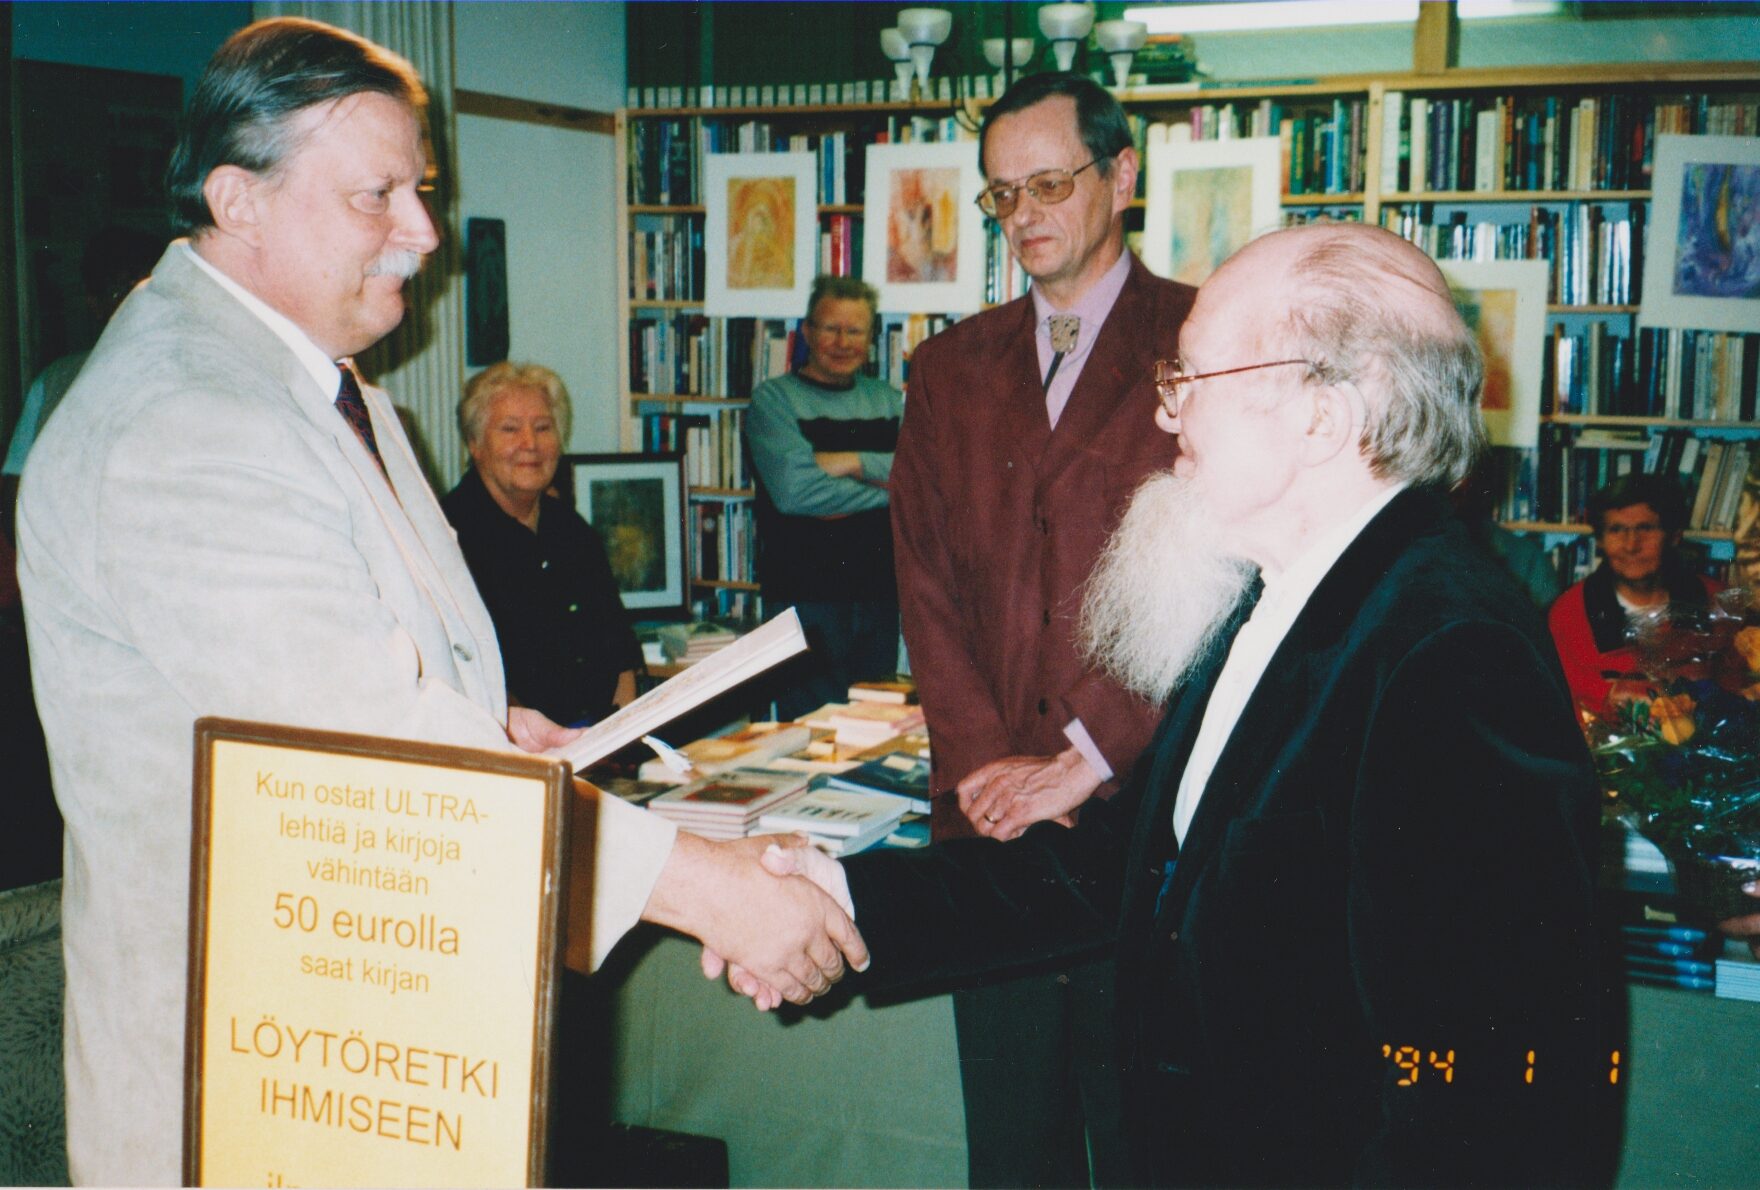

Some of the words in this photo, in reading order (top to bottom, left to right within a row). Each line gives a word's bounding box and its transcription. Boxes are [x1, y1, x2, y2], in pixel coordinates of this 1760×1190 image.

[255, 771, 306, 801] Kun
[313, 782, 375, 811] ostat
[384, 788, 489, 824] ULTRA-
[279, 812, 347, 847] lehtiä
[352, 822, 376, 850] ja
[384, 827, 461, 863] kirjoja
[306, 858, 429, 896] vähintään
[273, 892, 319, 933] 50
[331, 908, 460, 957] eurolla
[300, 952, 353, 982] saat
[362, 958, 430, 994] kirjan
[230, 1014, 499, 1100] LÖYTÖRETKI
[260, 1077, 463, 1152] IHMISEEN
